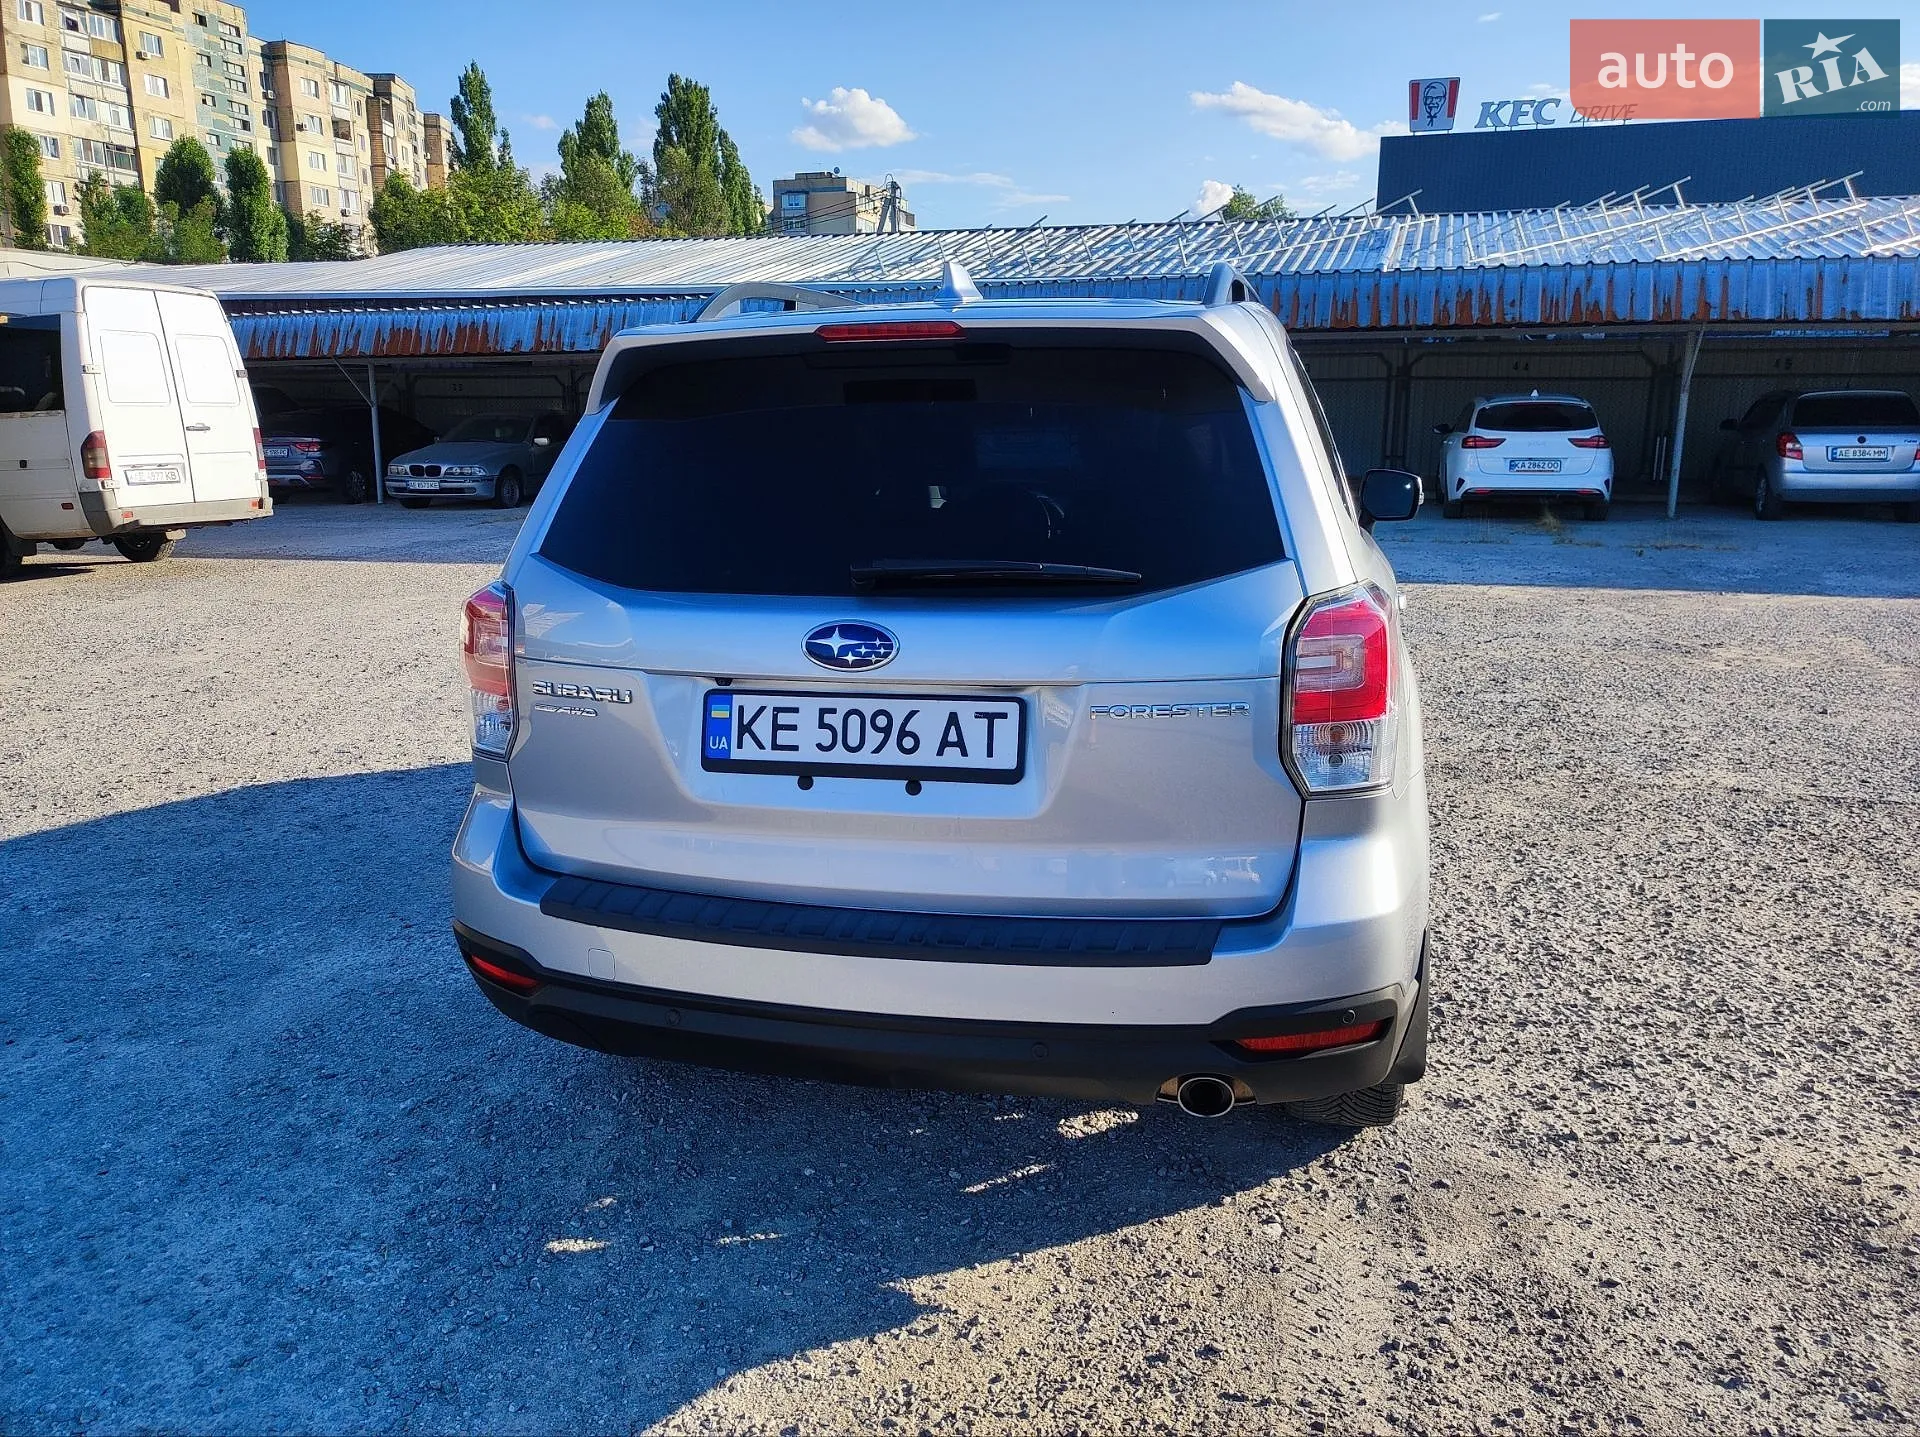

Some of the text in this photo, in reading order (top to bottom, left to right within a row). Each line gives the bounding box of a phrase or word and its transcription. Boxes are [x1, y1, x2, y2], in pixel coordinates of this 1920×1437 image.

[1474, 98, 1638, 129] KFC DRIVE
[532, 680, 633, 704] SUBARU
[1090, 702, 1250, 719] FORESTER
[710, 735, 729, 750] UA
[736, 704, 1009, 758] KE 5096 AT
